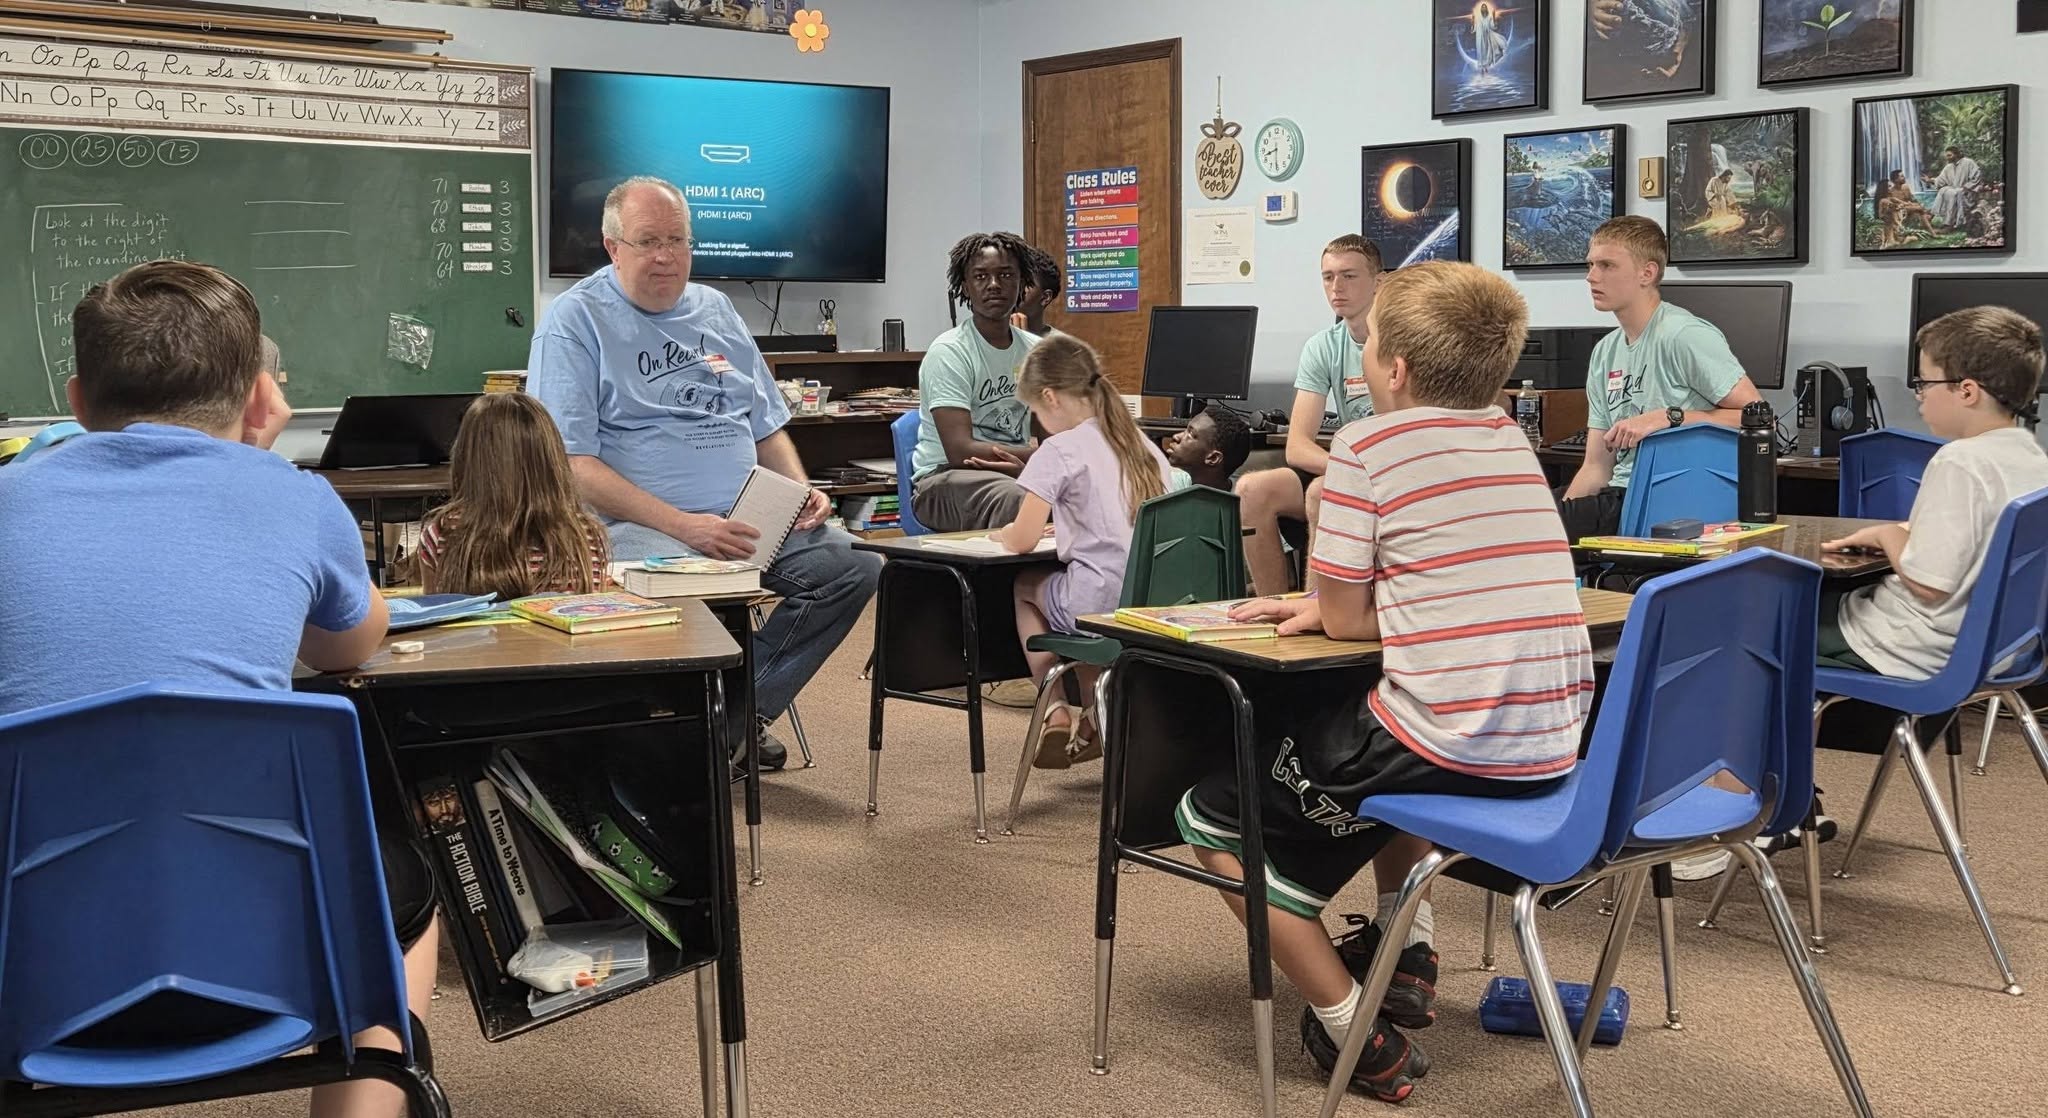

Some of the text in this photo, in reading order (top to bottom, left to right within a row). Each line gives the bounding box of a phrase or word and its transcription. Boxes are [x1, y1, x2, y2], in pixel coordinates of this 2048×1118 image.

[31, 44, 63, 66] Oo
[72, 47, 101, 77] Pp
[113, 50, 148, 80] Qq
[161, 54, 192, 75] Rr
[206, 58, 234, 79] Ss
[243, 60, 271, 80] Tt
[278, 62, 310, 86] Uu
[317, 65, 347, 86] Vv
[353, 68, 391, 89] Ww
[393, 71, 427, 92] Xx
[435, 74, 464, 100] Yy
[473, 77, 496, 104] Zz
[0, 82, 495, 136] Nn Oo Pp Qq Rr Ss Tt Uu Vv Ww Xx Yy Zz
[80, 137, 107, 158] 25
[124, 140, 147, 160] 50
[1198, 142, 1237, 167] Best
[1066, 170, 1136, 189] Class Rules
[1200, 160, 1236, 180] teacher
[432, 178, 447, 193] 71
[500, 181, 510, 193] 3
[685, 185, 765, 201] HDMI 1 (ARC)
[1205, 180, 1229, 192] ever
[431, 199, 448, 216] 70
[499, 202, 512, 216] 3
[1069, 194, 1078, 206] 1.
[45, 210, 169, 236] Look at the digit
[697, 210, 752, 220] (HDMI 1 (ARC))
[1067, 215, 1077, 226] 2.
[431, 218, 446, 233] 68
[500, 221, 512, 234] 3
[52, 229, 167, 254] to the right of
[436, 242, 453, 260] 70
[500, 238, 512, 252] 3
[1067, 235, 1077, 246] 3.
[56, 252, 81, 269] the
[437, 260, 454, 279] 64
[500, 260, 512, 275] 3
[1067, 255, 1078, 266] 4.
[1067, 275, 1078, 287] 5.
[1067, 296, 1078, 307] 6.
[638, 351, 662, 376] On
[980, 375, 1017, 401] On Rec
[488, 808, 526, 896] A Time to Weave
[446, 832, 487, 914] THE ACTION BIBLE
